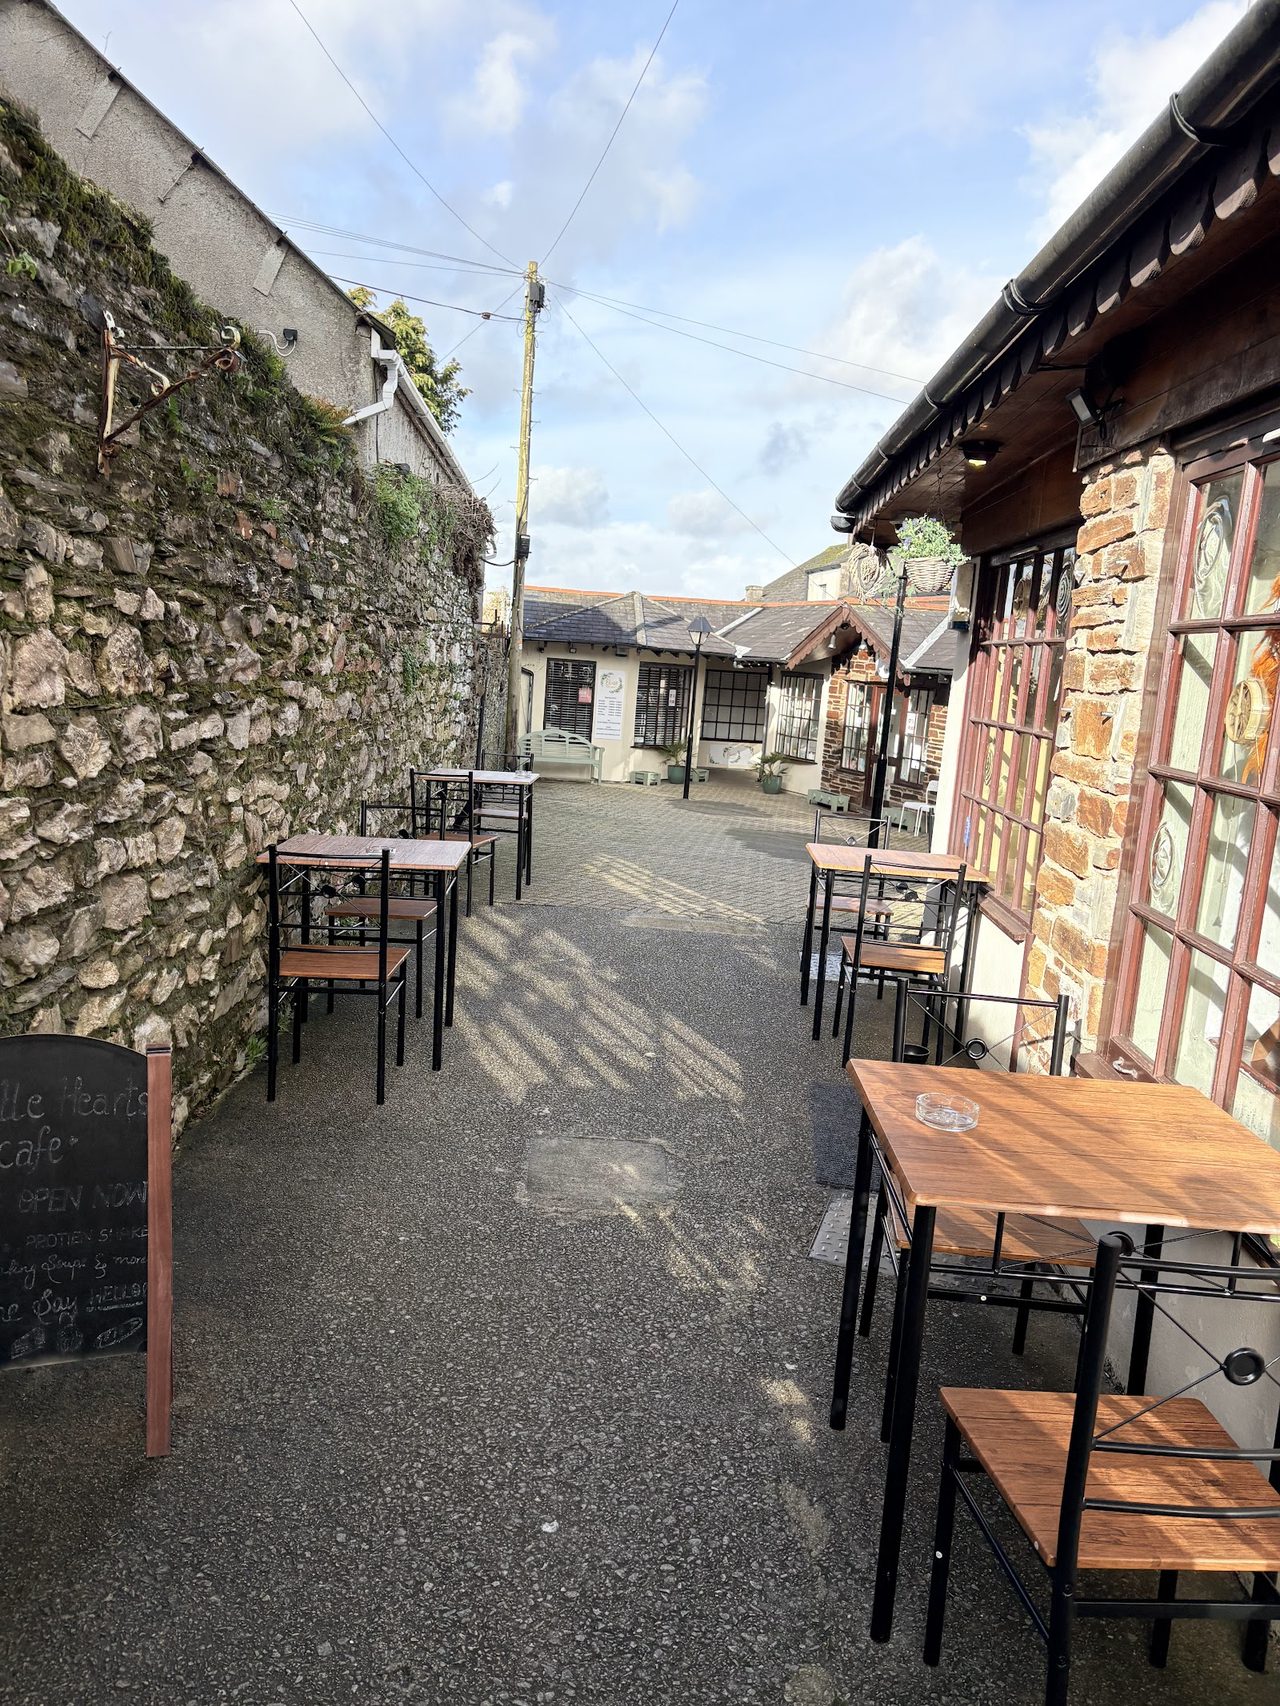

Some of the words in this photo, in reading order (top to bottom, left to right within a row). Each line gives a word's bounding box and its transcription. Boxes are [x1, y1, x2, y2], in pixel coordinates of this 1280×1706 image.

[56, 1075, 147, 1118] Hearts
[18, 1185, 83, 1213] OPEN
[92, 1180, 147, 1209] NOW
